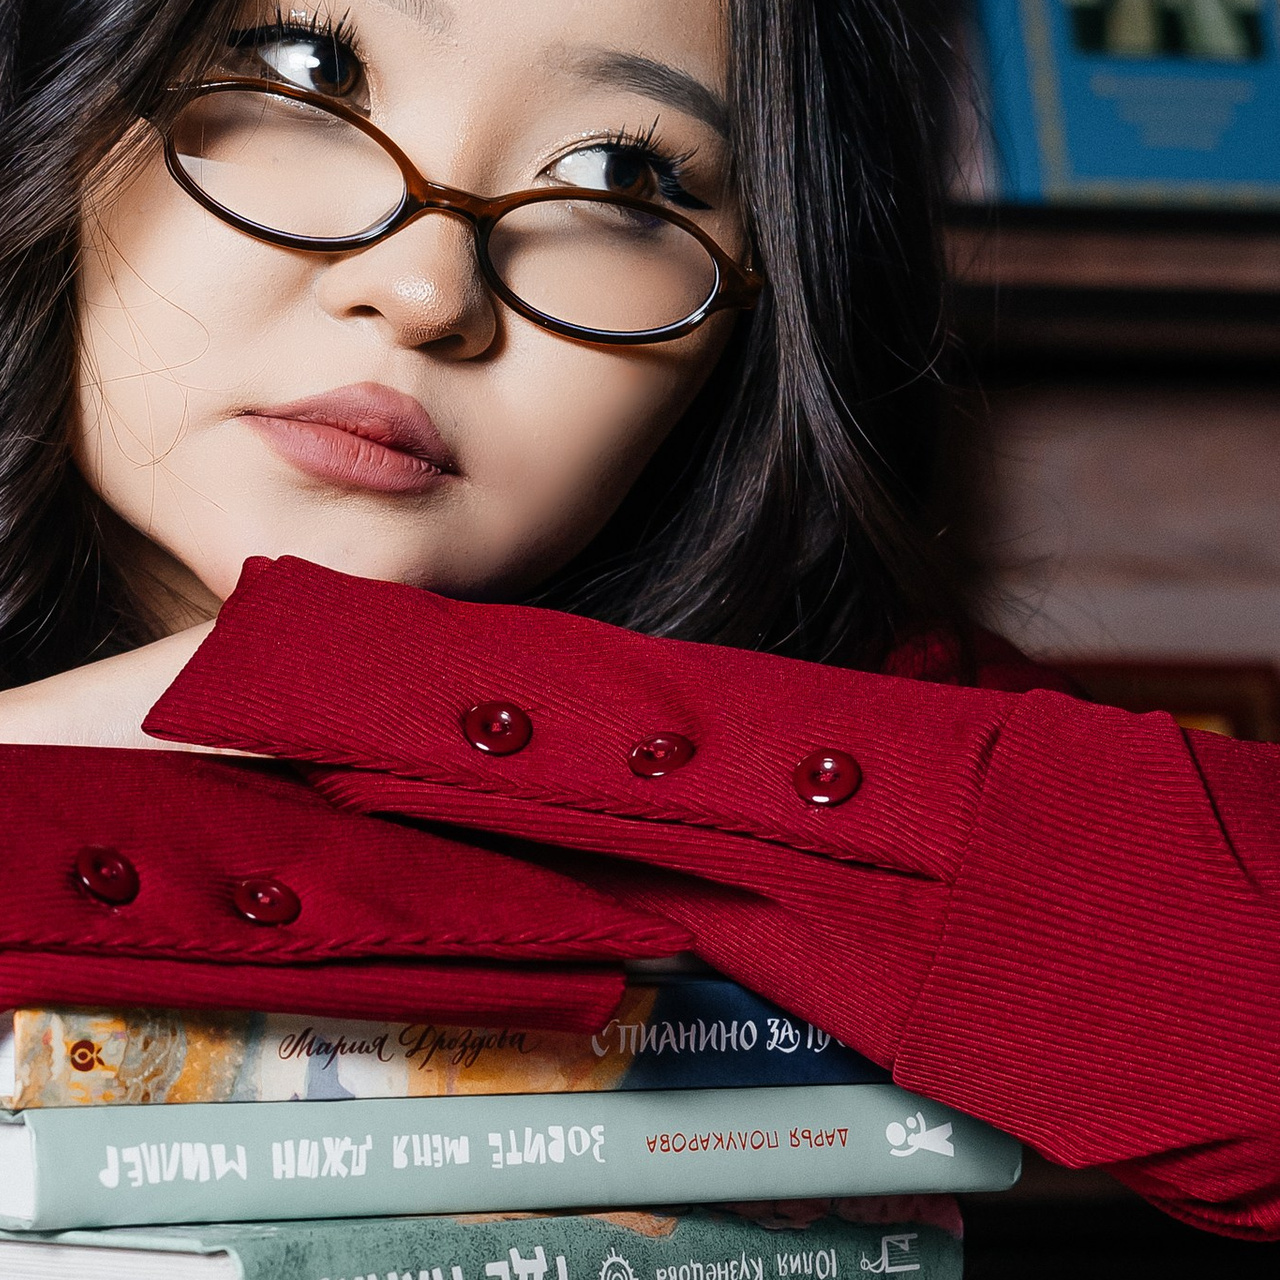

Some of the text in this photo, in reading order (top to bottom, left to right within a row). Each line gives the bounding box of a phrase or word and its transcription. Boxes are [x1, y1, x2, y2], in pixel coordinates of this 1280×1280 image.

[278, 1023, 540, 1070] Мария Дроздова
[617, 1018, 757, 1056] ПИАНИНО
[766, 1018, 800, 1054] ЗА
[99, 1124, 607, 1188] ЗОВИТЕ МЕНЯ ДЖИН МИЛЛЕР
[646, 1127, 849, 1154] ДАРЬЯ ПОЛУКАРОВА
[778, 1249, 836, 1279] Юлия
